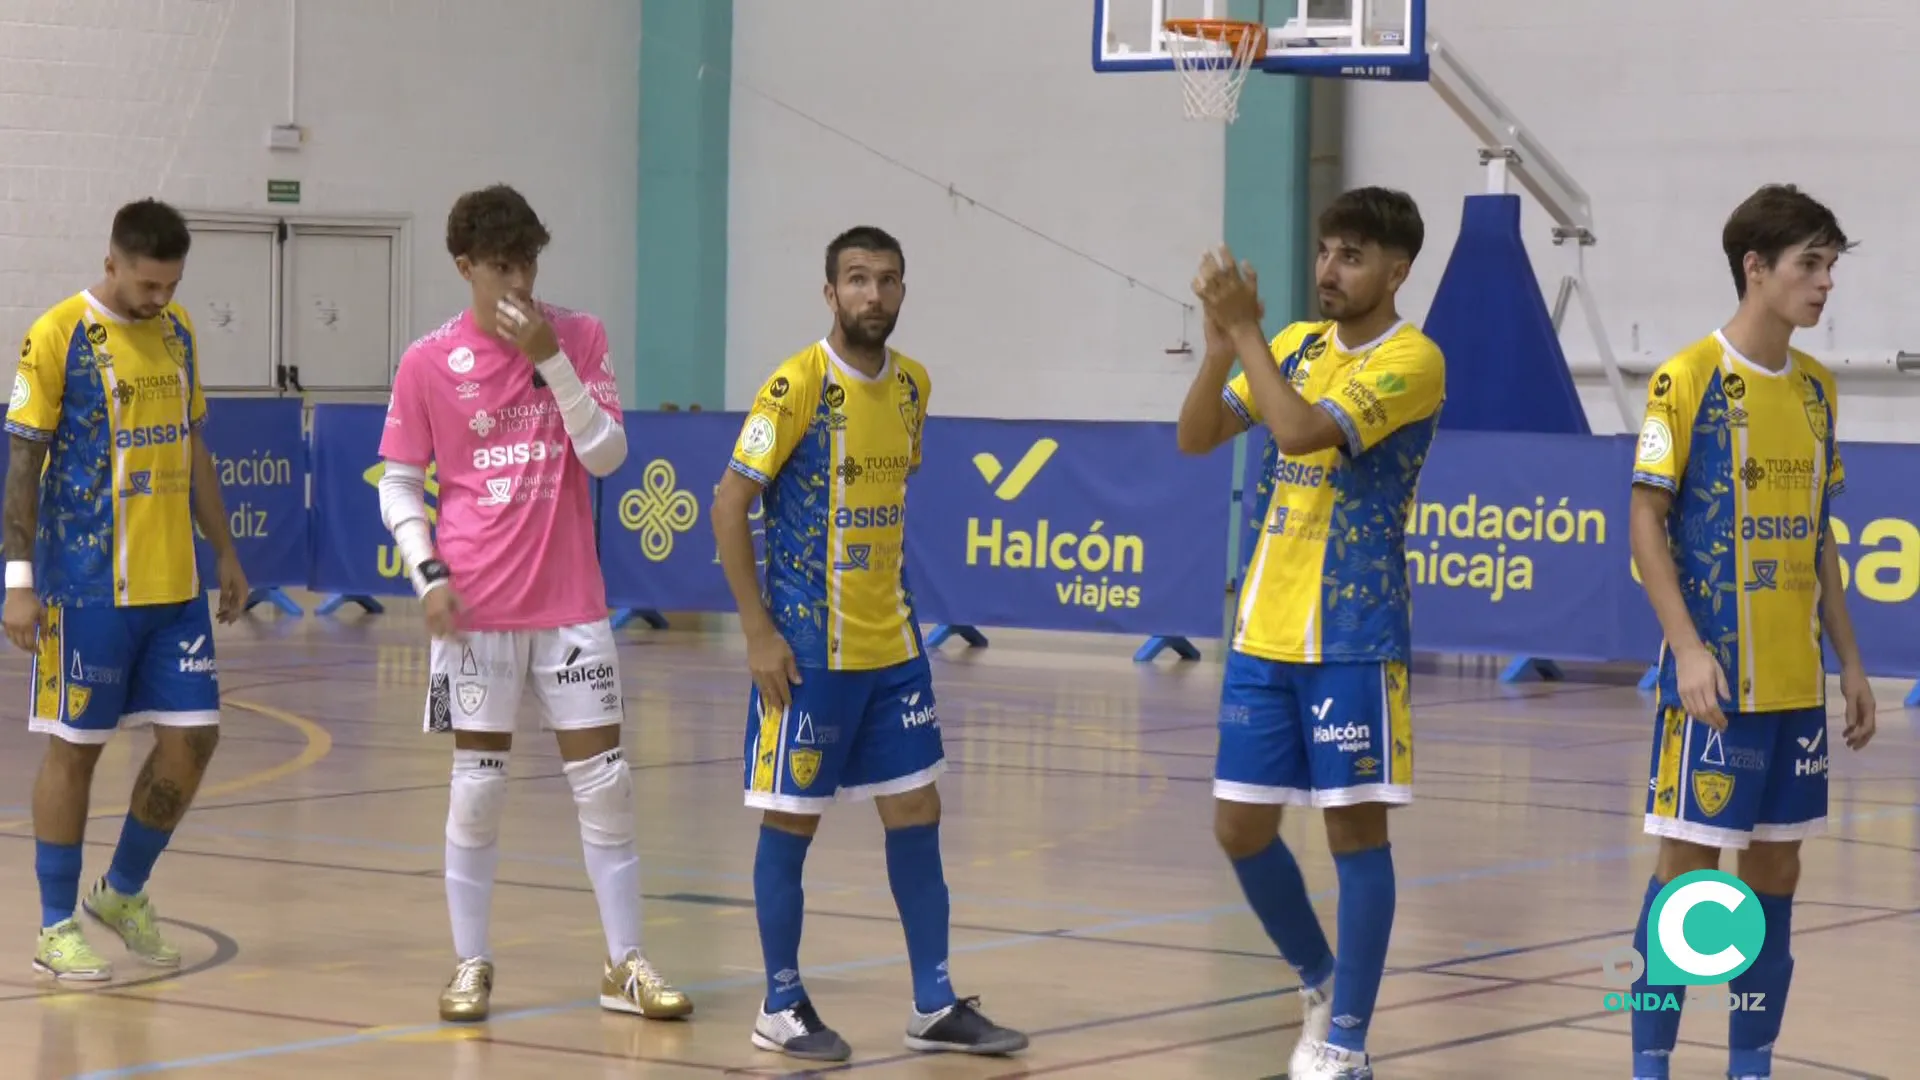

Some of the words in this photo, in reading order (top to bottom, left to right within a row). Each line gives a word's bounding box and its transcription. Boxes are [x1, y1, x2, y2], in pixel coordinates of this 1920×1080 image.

[116, 424, 177, 449] asisa
[473, 441, 546, 470] asisa
[835, 504, 899, 529] asisa
[1741, 515, 1808, 540] asisa
[966, 516, 1144, 574] Halcón
[1055, 574, 1141, 612] viajes
[556, 663, 614, 685] Halcón
[1313, 721, 1371, 744] Halcón
